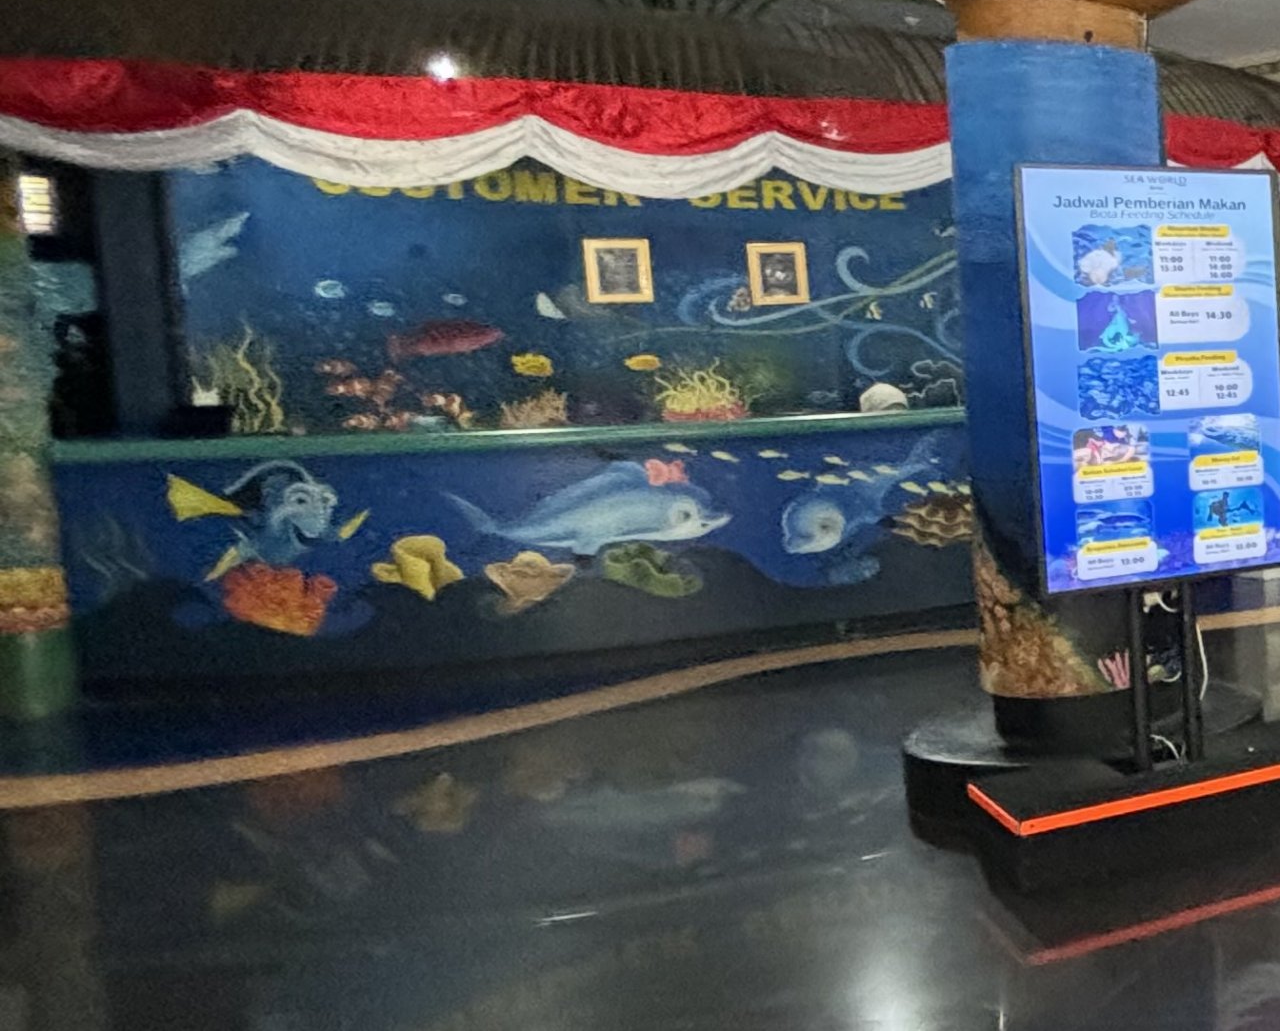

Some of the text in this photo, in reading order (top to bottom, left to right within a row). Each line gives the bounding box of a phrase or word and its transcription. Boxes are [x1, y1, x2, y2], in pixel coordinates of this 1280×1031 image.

[1123, 174, 1145, 185] SEA
[1146, 175, 1188, 188] WORLD
[1053, 194, 1247, 211] Jadwal Pemberian Makan
[1089, 209, 1216, 220] Biota Feeding Schedule
